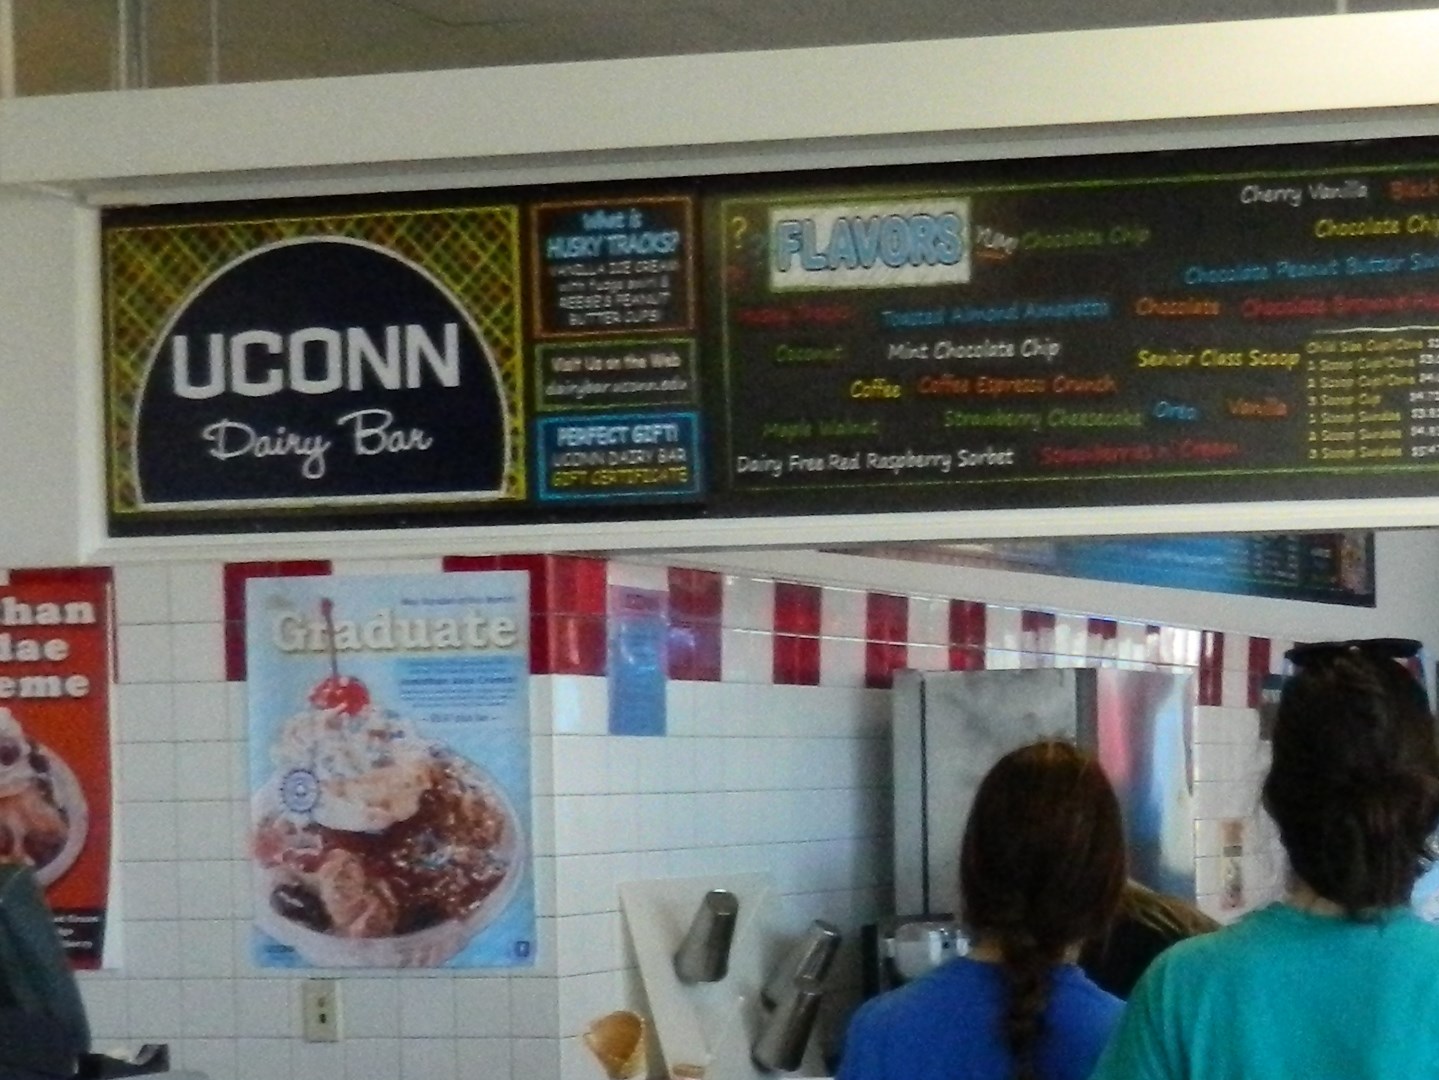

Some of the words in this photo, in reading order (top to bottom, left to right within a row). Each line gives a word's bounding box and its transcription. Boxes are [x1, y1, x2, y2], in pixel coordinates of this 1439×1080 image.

[1239, 183, 1303, 208] Cherry
[1307, 179, 1369, 200] Vanilla
[775, 211, 963, 273] FLAVORS
[1315, 217, 1400, 239] Chocolate
[171, 322, 462, 400] UCONN
[887, 341, 929, 360] Mint
[933, 339, 1015, 361] Chocolate
[1020, 337, 1062, 363] Chip
[1137, 349, 1195, 368] Senior
[1199, 349, 1243, 367] Class
[1248, 348, 1301, 371] Scoop
[850, 376, 903, 400] Coffee
[201, 417, 332, 479] Dairy
[337, 408, 434, 456] Bar
[737, 452, 784, 478] Dairy
[788, 453, 826, 474] Free
[827, 450, 861, 471] Red
[865, 449, 953, 476] Raspberry
[956, 444, 1015, 468] Sorbet
[273, 608, 519, 654] Graduate
